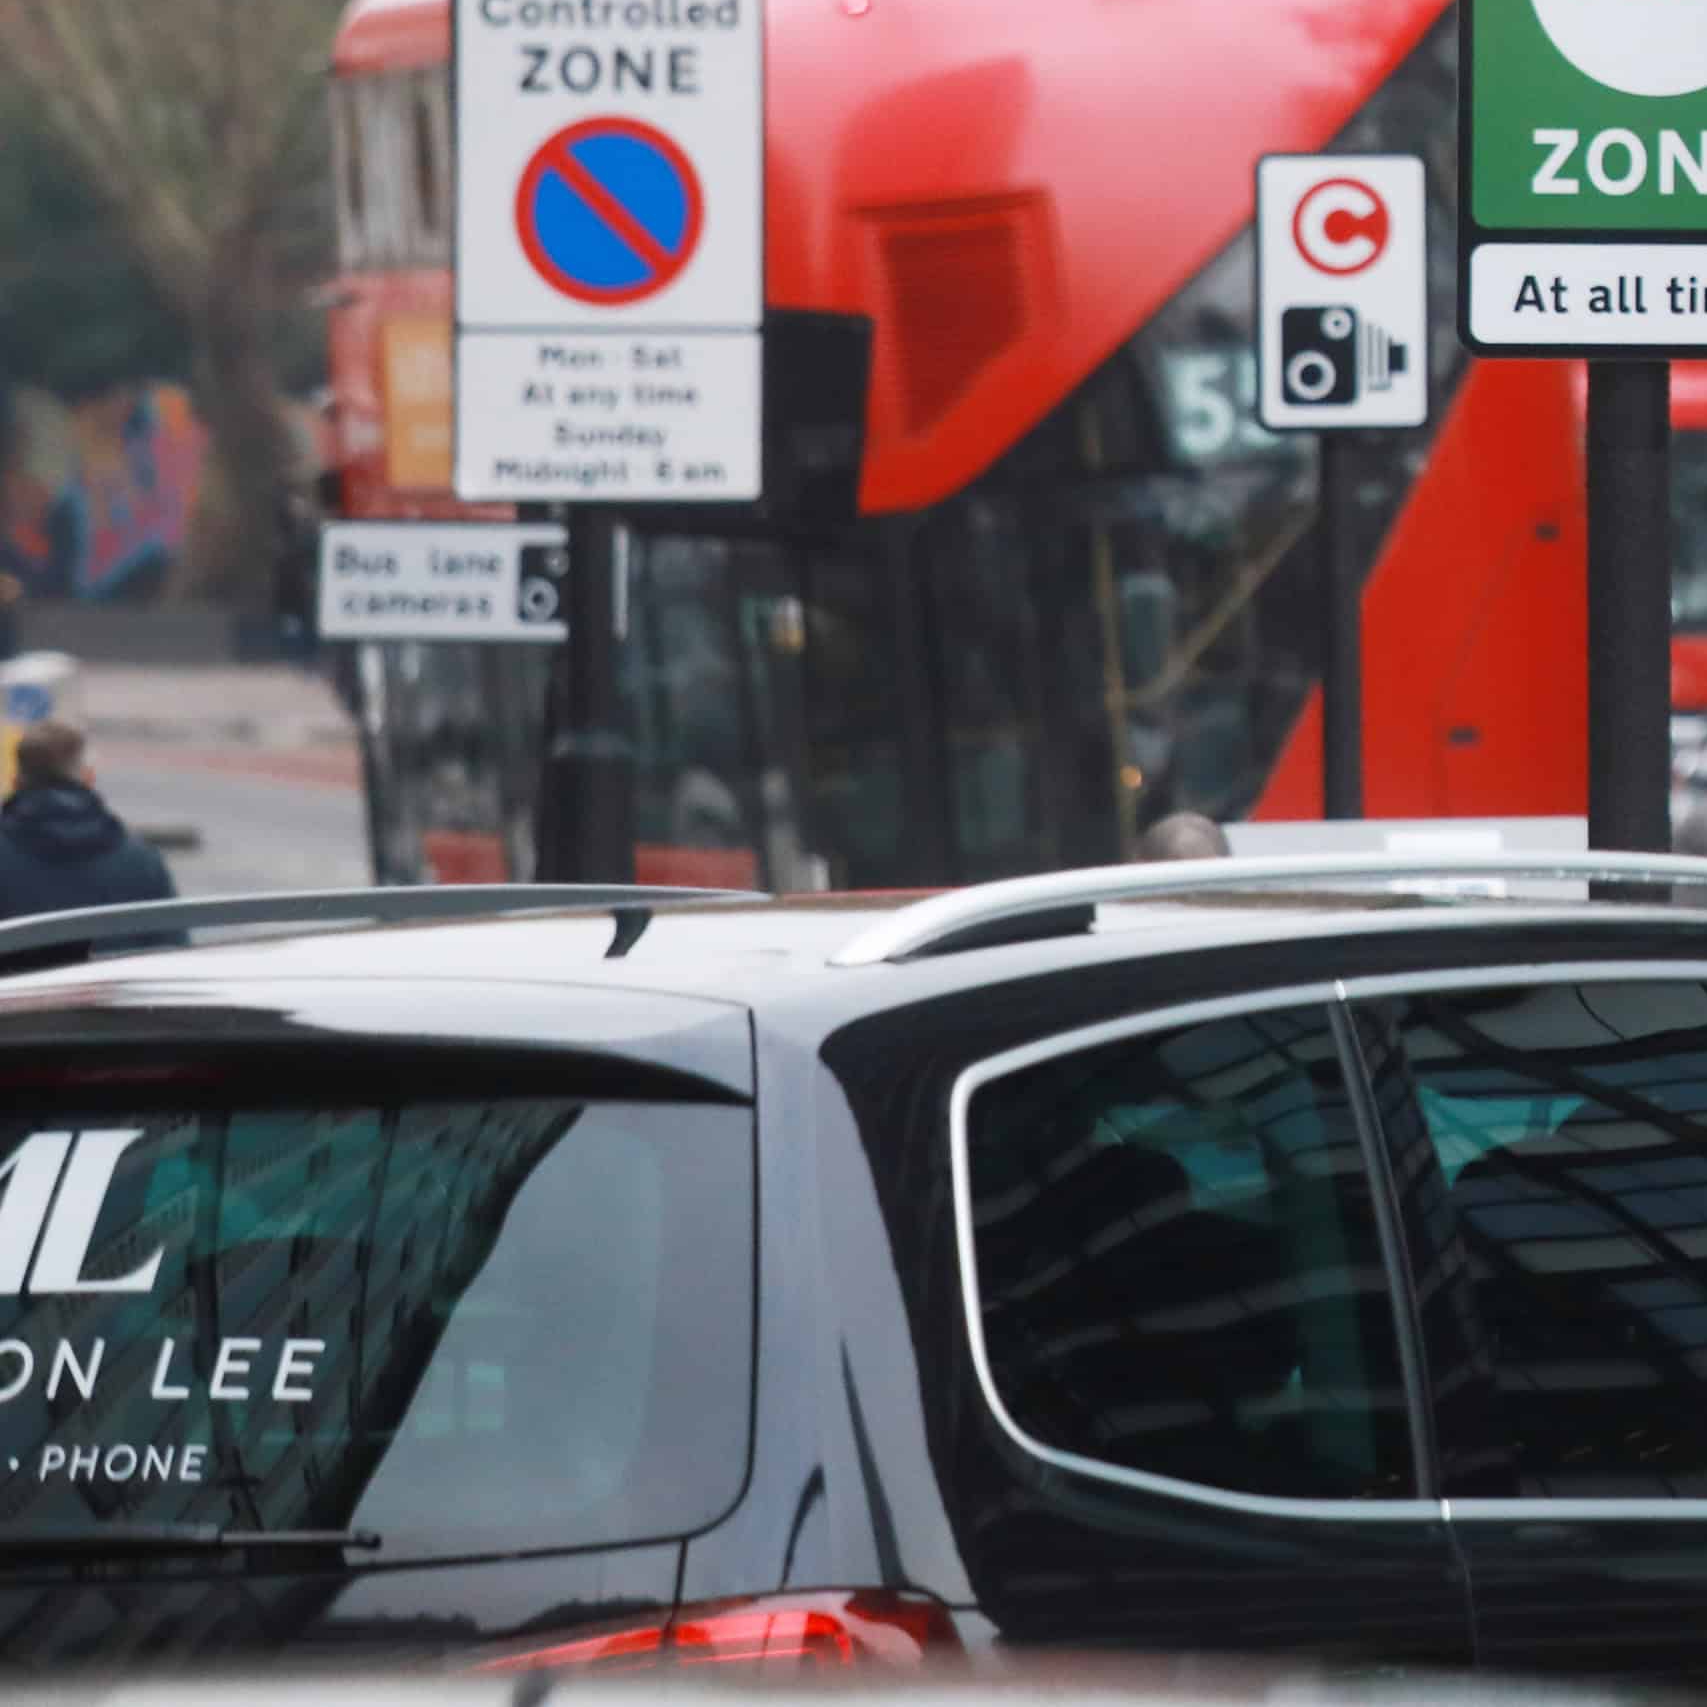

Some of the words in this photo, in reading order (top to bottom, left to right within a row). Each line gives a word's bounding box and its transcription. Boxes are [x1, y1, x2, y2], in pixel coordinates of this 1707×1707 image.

[518, 45, 702, 96] ZONE
[1513, 274, 1569, 315] At
[1587, 275, 1648, 315] all
[521, 382, 554, 405] At
[568, 386, 620, 410] any
[633, 383, 697, 405] time
[553, 422, 668, 448] Sunday
[493, 459, 629, 488] Midnight
[334, 545, 398, 574] Bus
[430, 545, 502, 574] lane
[341, 595, 492, 617] cameras
[151, 1338, 326, 1401] LEE
[39, 1444, 208, 1482] PHONE
